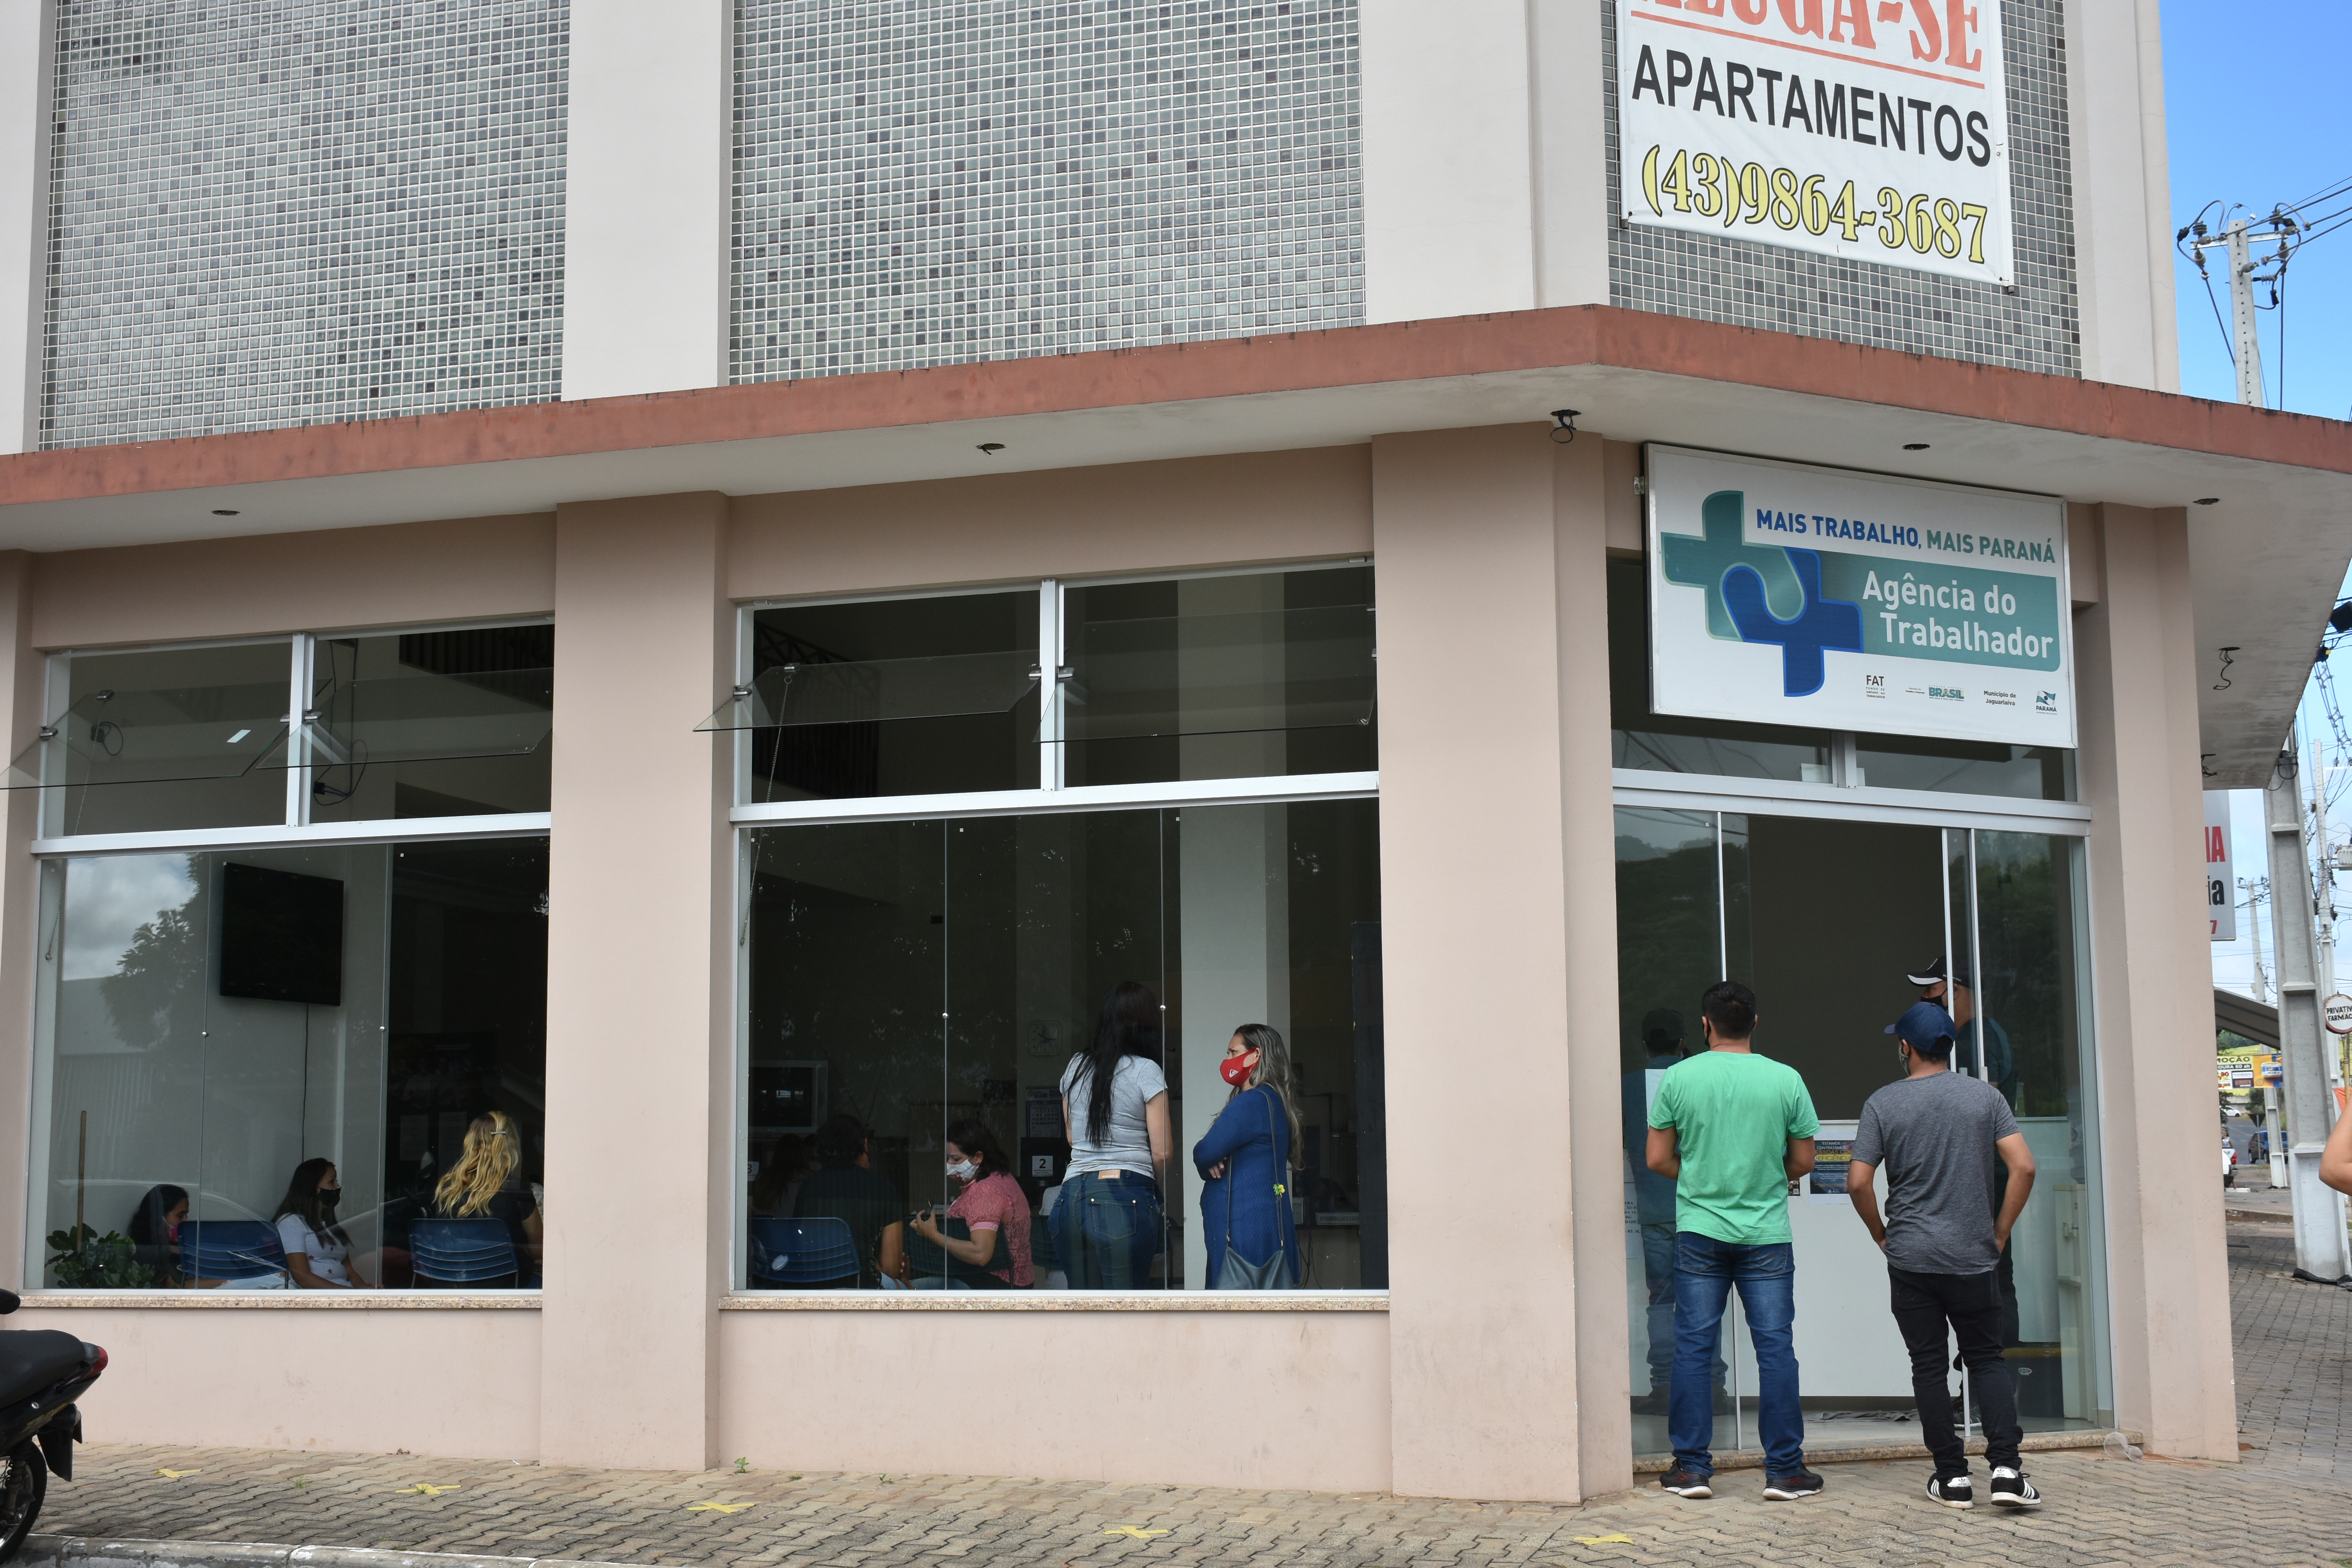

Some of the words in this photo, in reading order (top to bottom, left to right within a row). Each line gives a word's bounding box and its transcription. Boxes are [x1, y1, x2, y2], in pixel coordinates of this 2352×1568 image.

[1632, 44, 1990, 167] APARTAMENTOS
[1642, 144, 1987, 264] (43)9864-3687
[1757, 509, 1806, 534] MAIS
[1812, 516, 1922, 550] TRABALHO,
[1927, 529, 1973, 554] MAIS
[1979, 537, 2056, 563] PARANÁ
[1862, 570, 1975, 612] Agência
[1984, 585, 2016, 616] do
[1880, 611, 2053, 658] Trabalhador
[1866, 675, 1884, 686] FAT
[1929, 687, 1964, 699] BRASIL
[1039, 1158, 1046, 1169] 2
